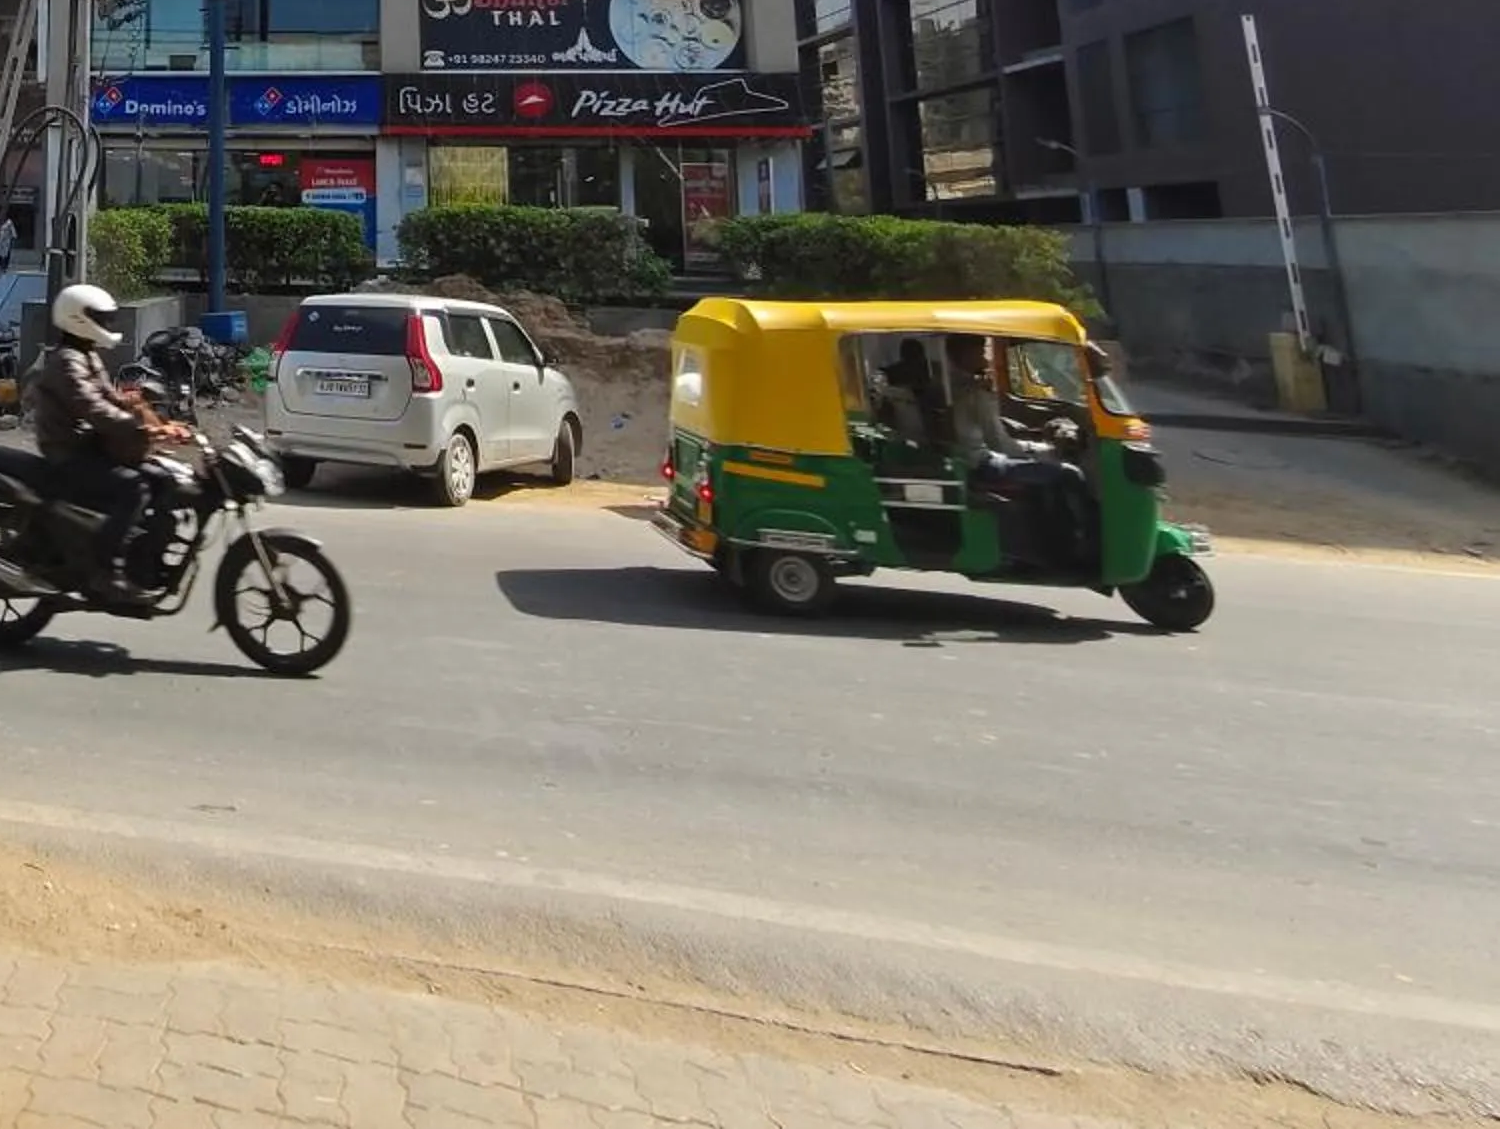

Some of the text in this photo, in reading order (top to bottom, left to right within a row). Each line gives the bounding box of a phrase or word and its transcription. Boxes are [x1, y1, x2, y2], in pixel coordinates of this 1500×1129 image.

[491, 10, 562, 27] THAL
[125, 100, 206, 116] Domino's
[571, 91, 653, 118] Pizza
